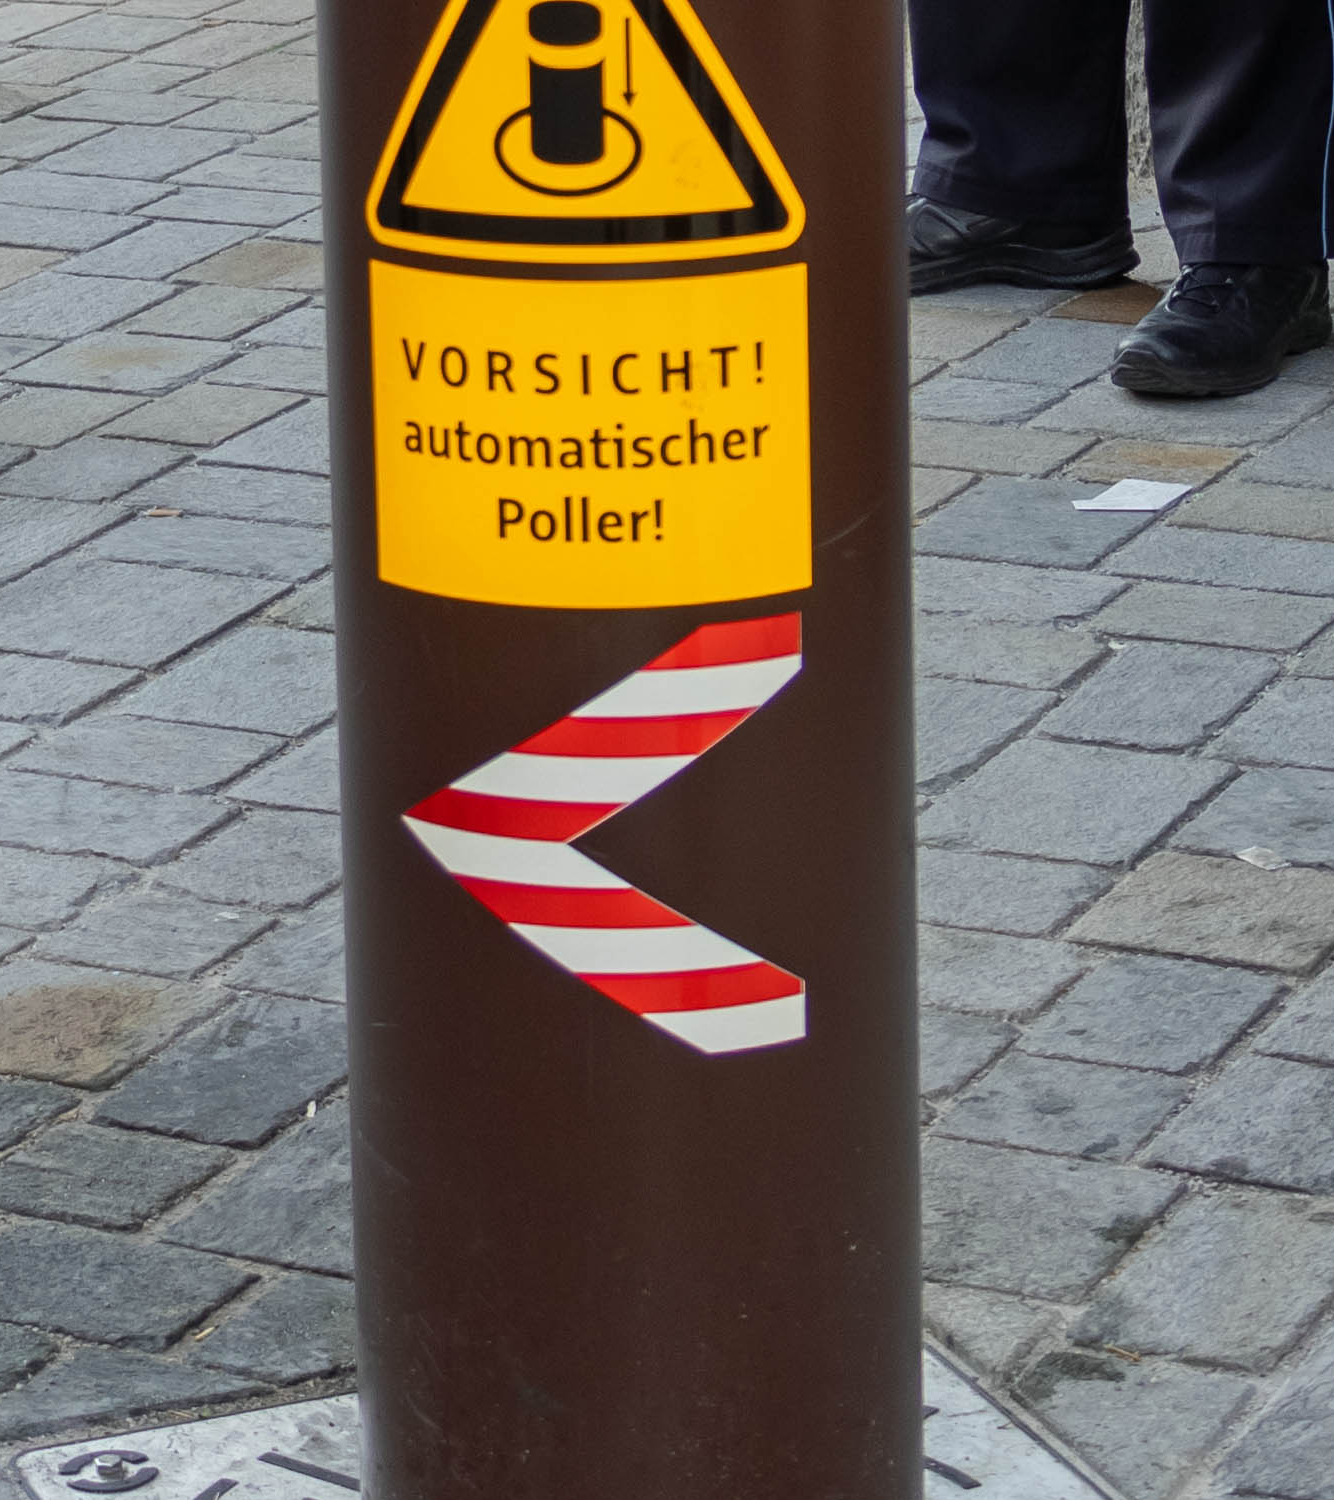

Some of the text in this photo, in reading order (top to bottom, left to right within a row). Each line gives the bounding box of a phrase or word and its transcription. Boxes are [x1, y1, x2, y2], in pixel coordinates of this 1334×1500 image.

[402, 337, 764, 396] VORSICHT!
[404, 418, 771, 470] automatischer
[498, 496, 665, 544] Poller!
